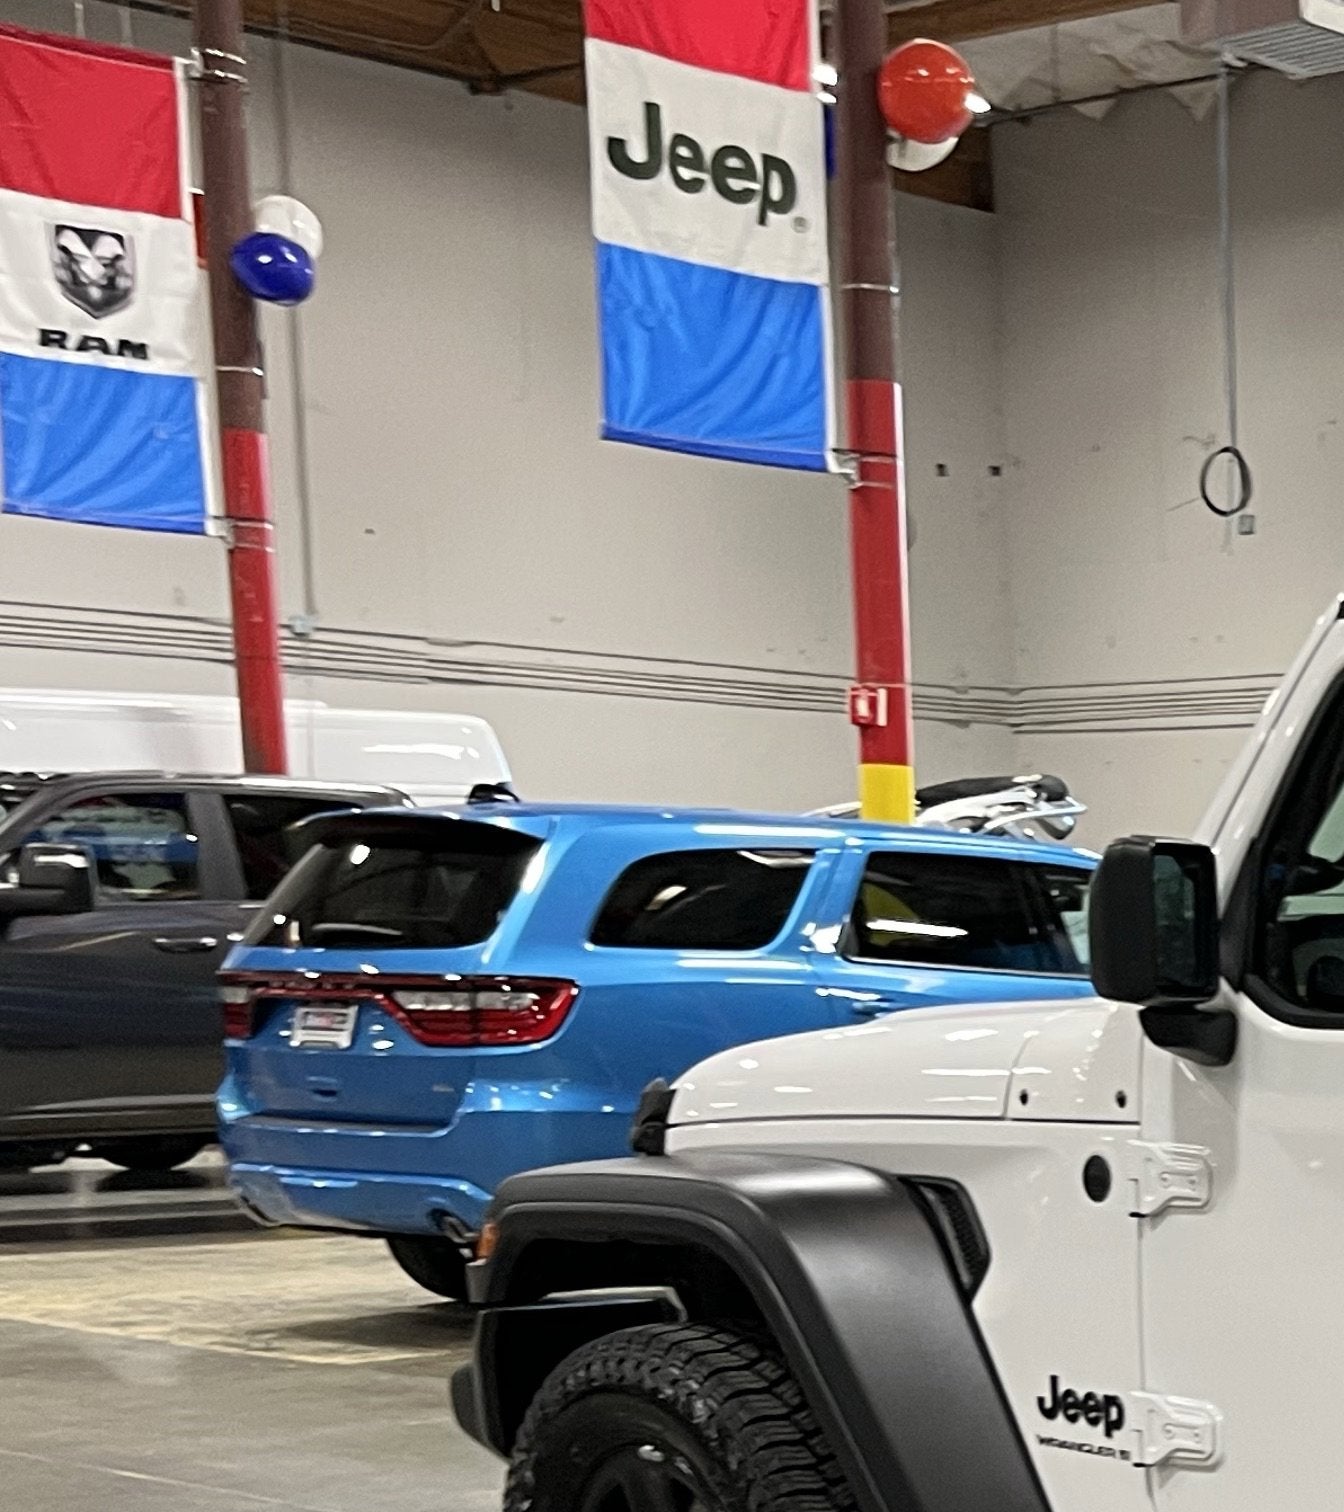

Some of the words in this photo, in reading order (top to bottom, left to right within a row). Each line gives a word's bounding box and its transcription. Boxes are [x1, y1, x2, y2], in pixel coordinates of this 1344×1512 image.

[607, 101, 797, 226] Jeep
[38, 328, 149, 360] RAM
[1036, 1374, 1125, 1438] Jeep
